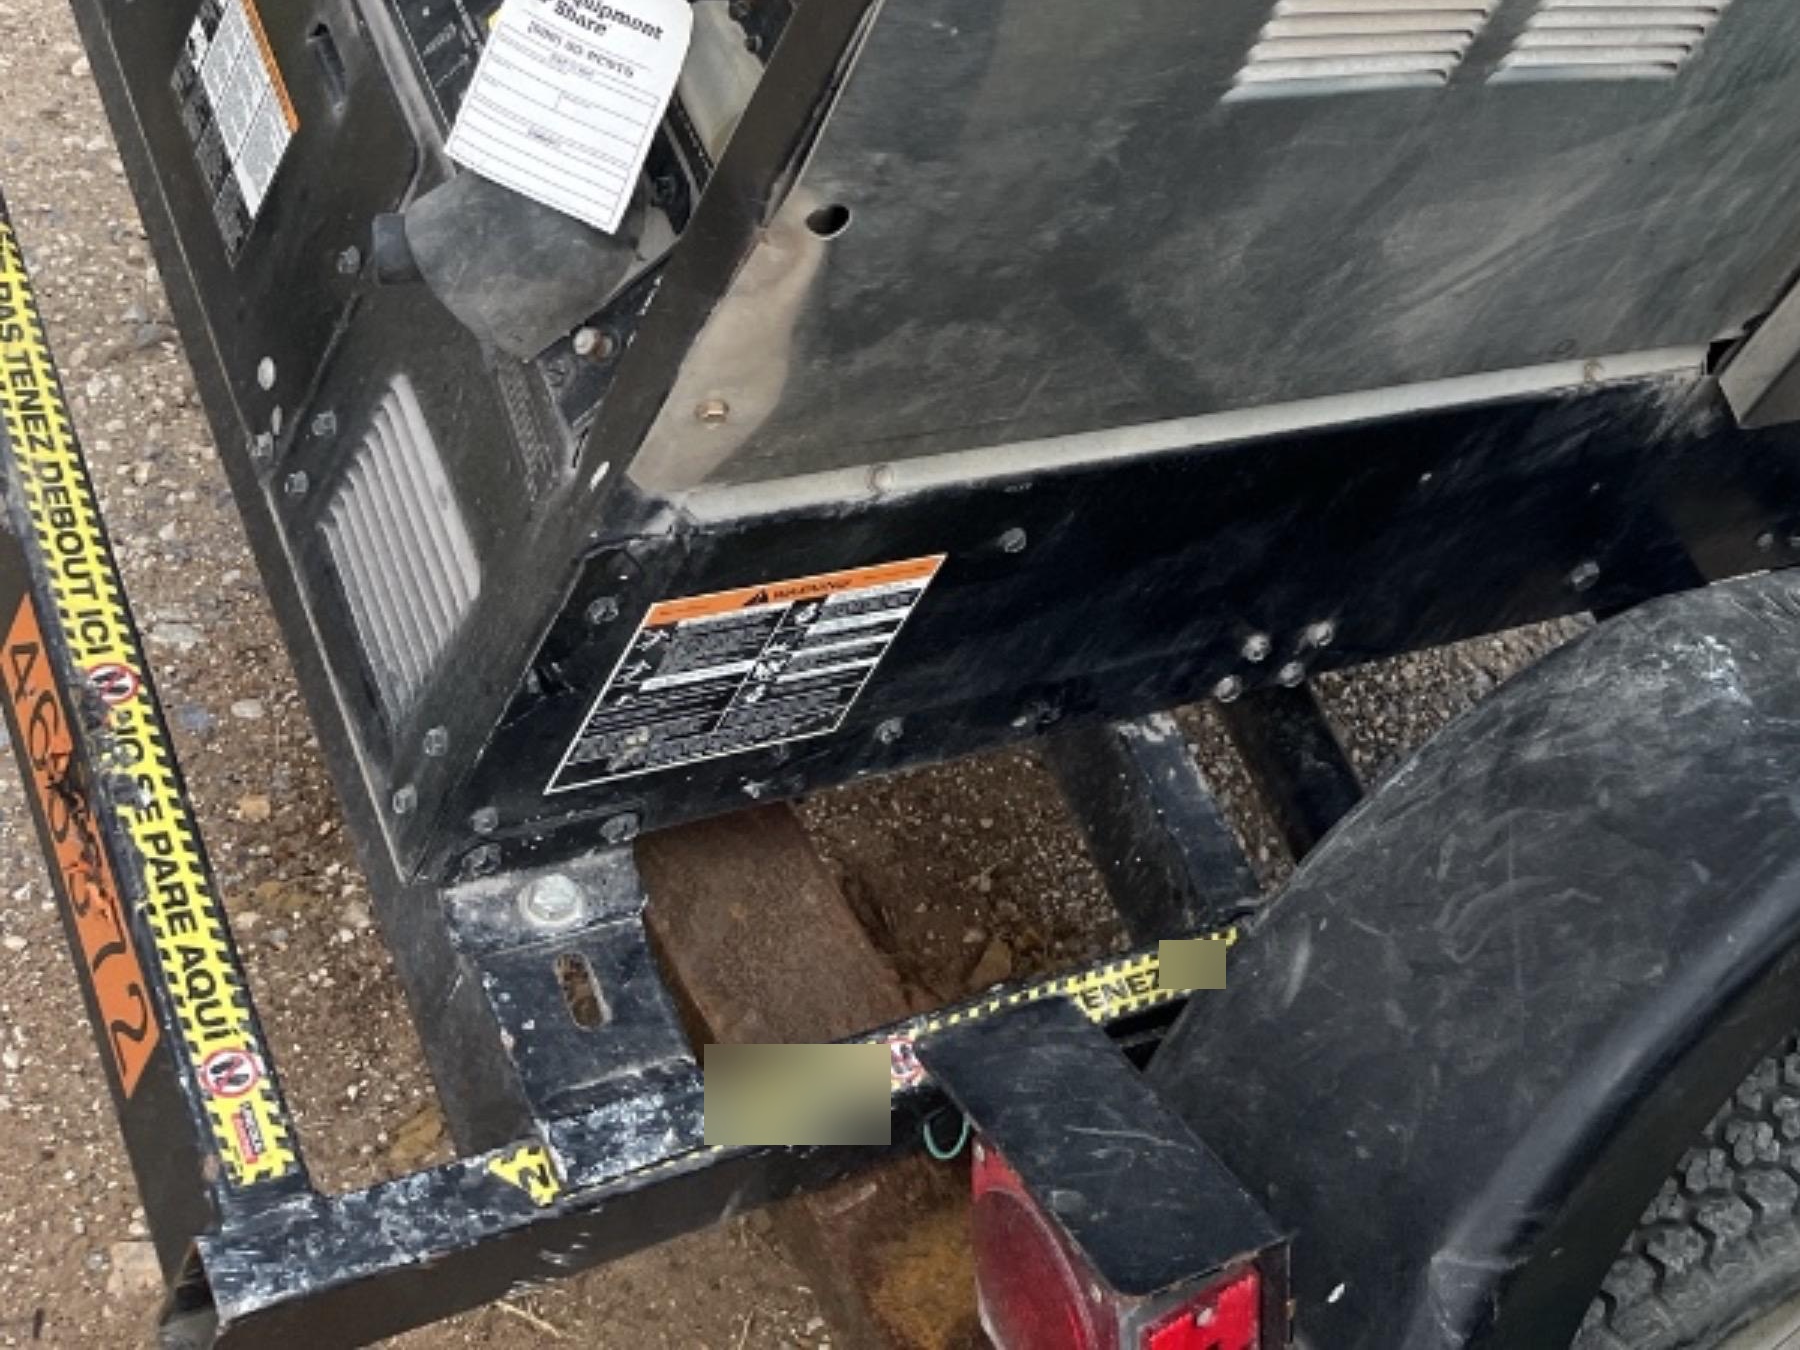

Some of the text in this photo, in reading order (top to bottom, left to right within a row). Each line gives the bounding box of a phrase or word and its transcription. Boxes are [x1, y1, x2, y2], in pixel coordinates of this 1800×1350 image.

[554, 0, 608, 36] Share
[6, 353, 54, 454] TENEZ
[36, 462, 99, 604] DEBOUT
[75, 607, 116, 657] ICI
[141, 829, 199, 937] PARE
[176, 942, 243, 1044] AQUÍ
